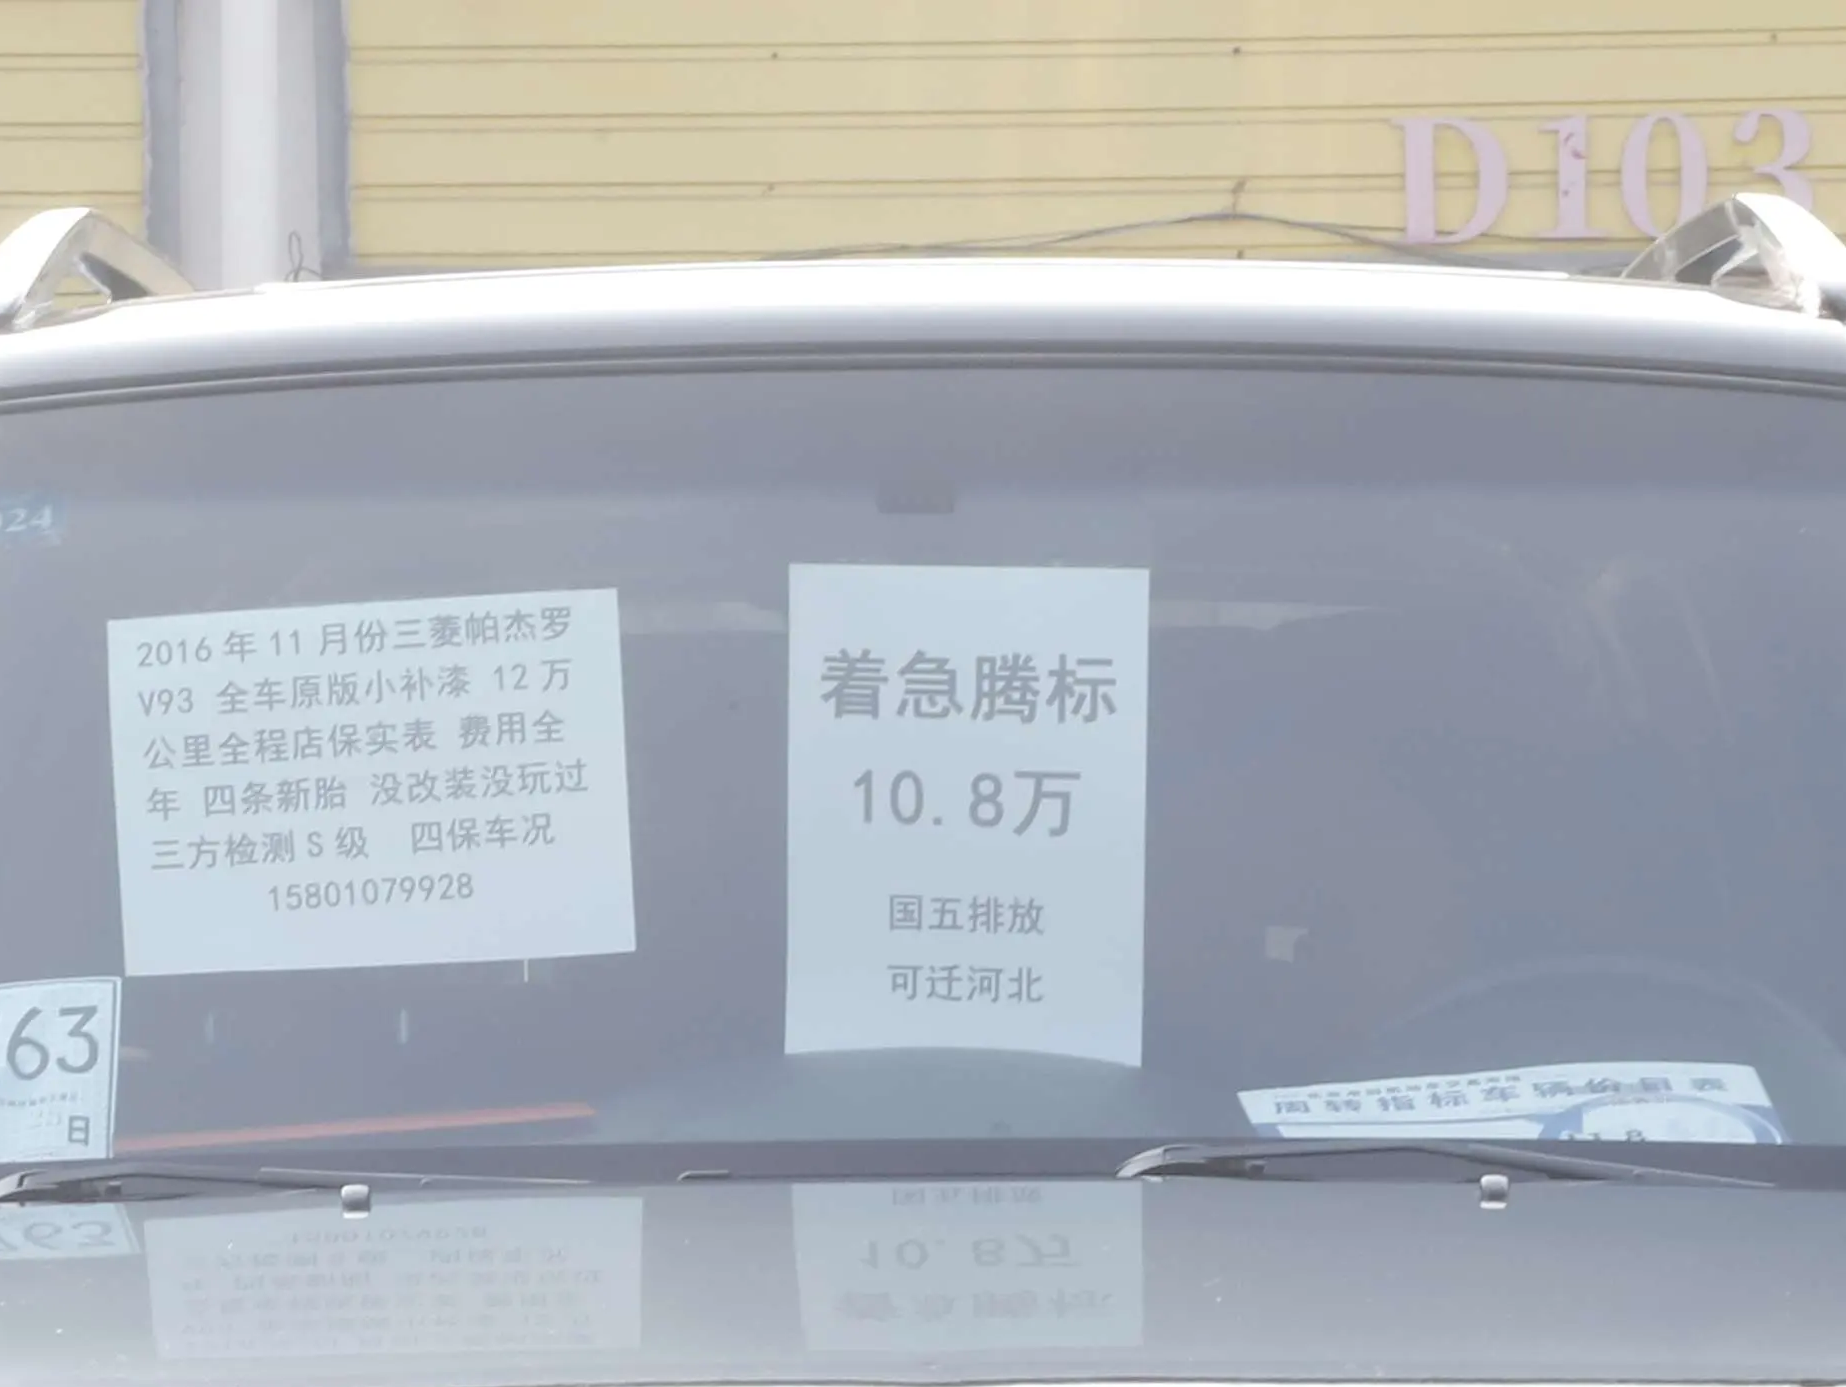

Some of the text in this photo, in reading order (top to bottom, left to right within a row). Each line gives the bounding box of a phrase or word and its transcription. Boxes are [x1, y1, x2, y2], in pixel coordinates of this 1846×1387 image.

[1390, 108, 1812, 244] D103
[136, 605, 572, 668] 2016 年 11 月份三菱帕杰罗
[137, 658, 572, 718] V93 全车原版小补漆 12 万
[819, 647, 1118, 725] 着急腾标
[143, 708, 565, 770] 公里全程店保实表 费用全
[146, 757, 589, 822] 年 四条新胎 没改装没玩过
[853, 768, 1082, 838] 10.8万
[150, 812, 556, 871] 三方检测 S 级 四保车况
[268, 872, 475, 912] 15801079928
[888, 893, 1045, 936] 国五排放
[886, 963, 1044, 1004] 可迁河北
[67, 1115, 90, 1147] 日
